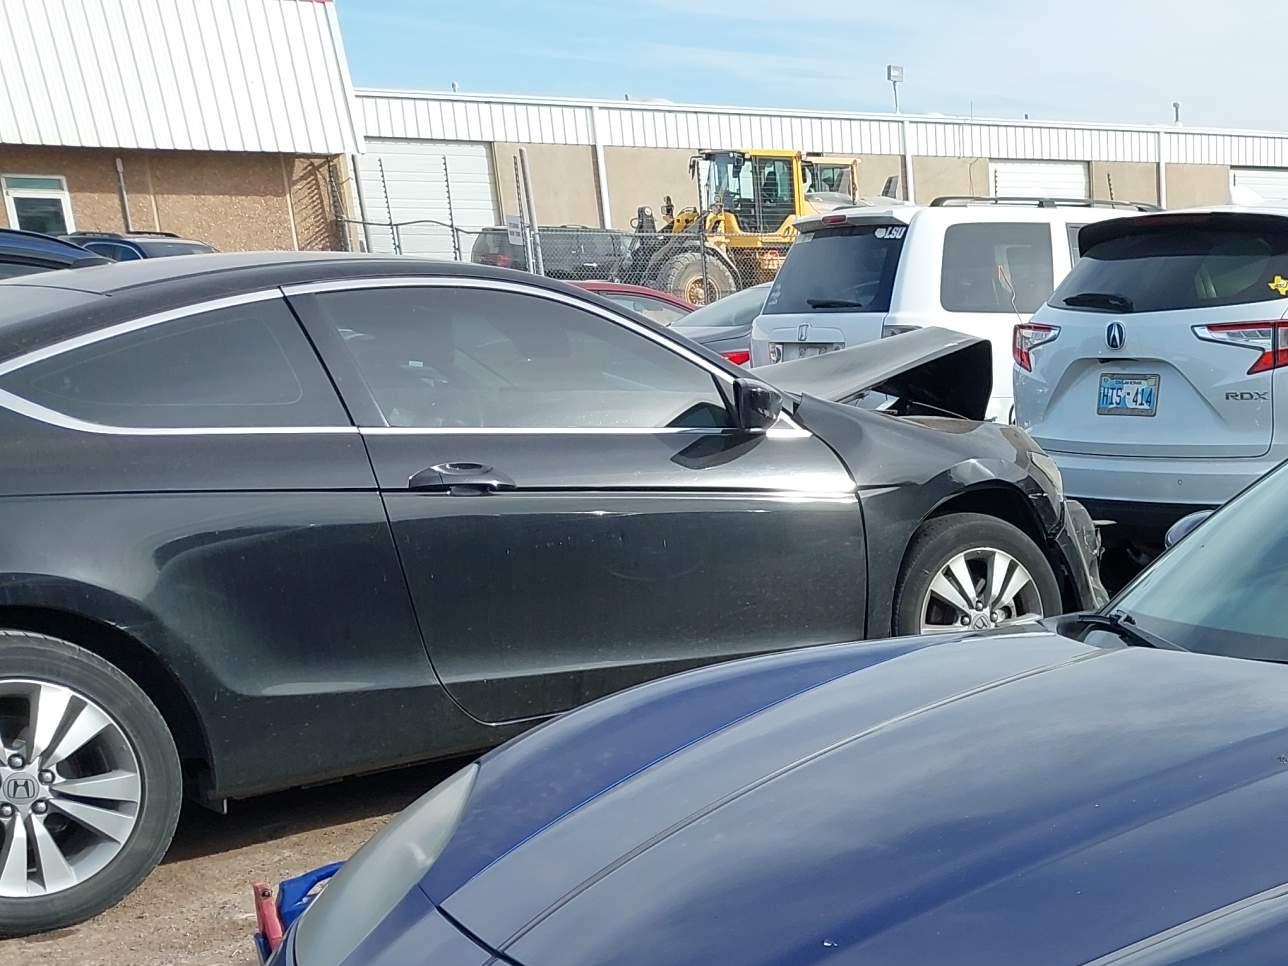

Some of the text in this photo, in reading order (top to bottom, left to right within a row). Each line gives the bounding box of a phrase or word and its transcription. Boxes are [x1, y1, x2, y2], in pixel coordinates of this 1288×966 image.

[884, 226, 907, 239] LSU
[1132, 387, 1153, 407] 414
[1225, 391, 1270, 401] RDX
